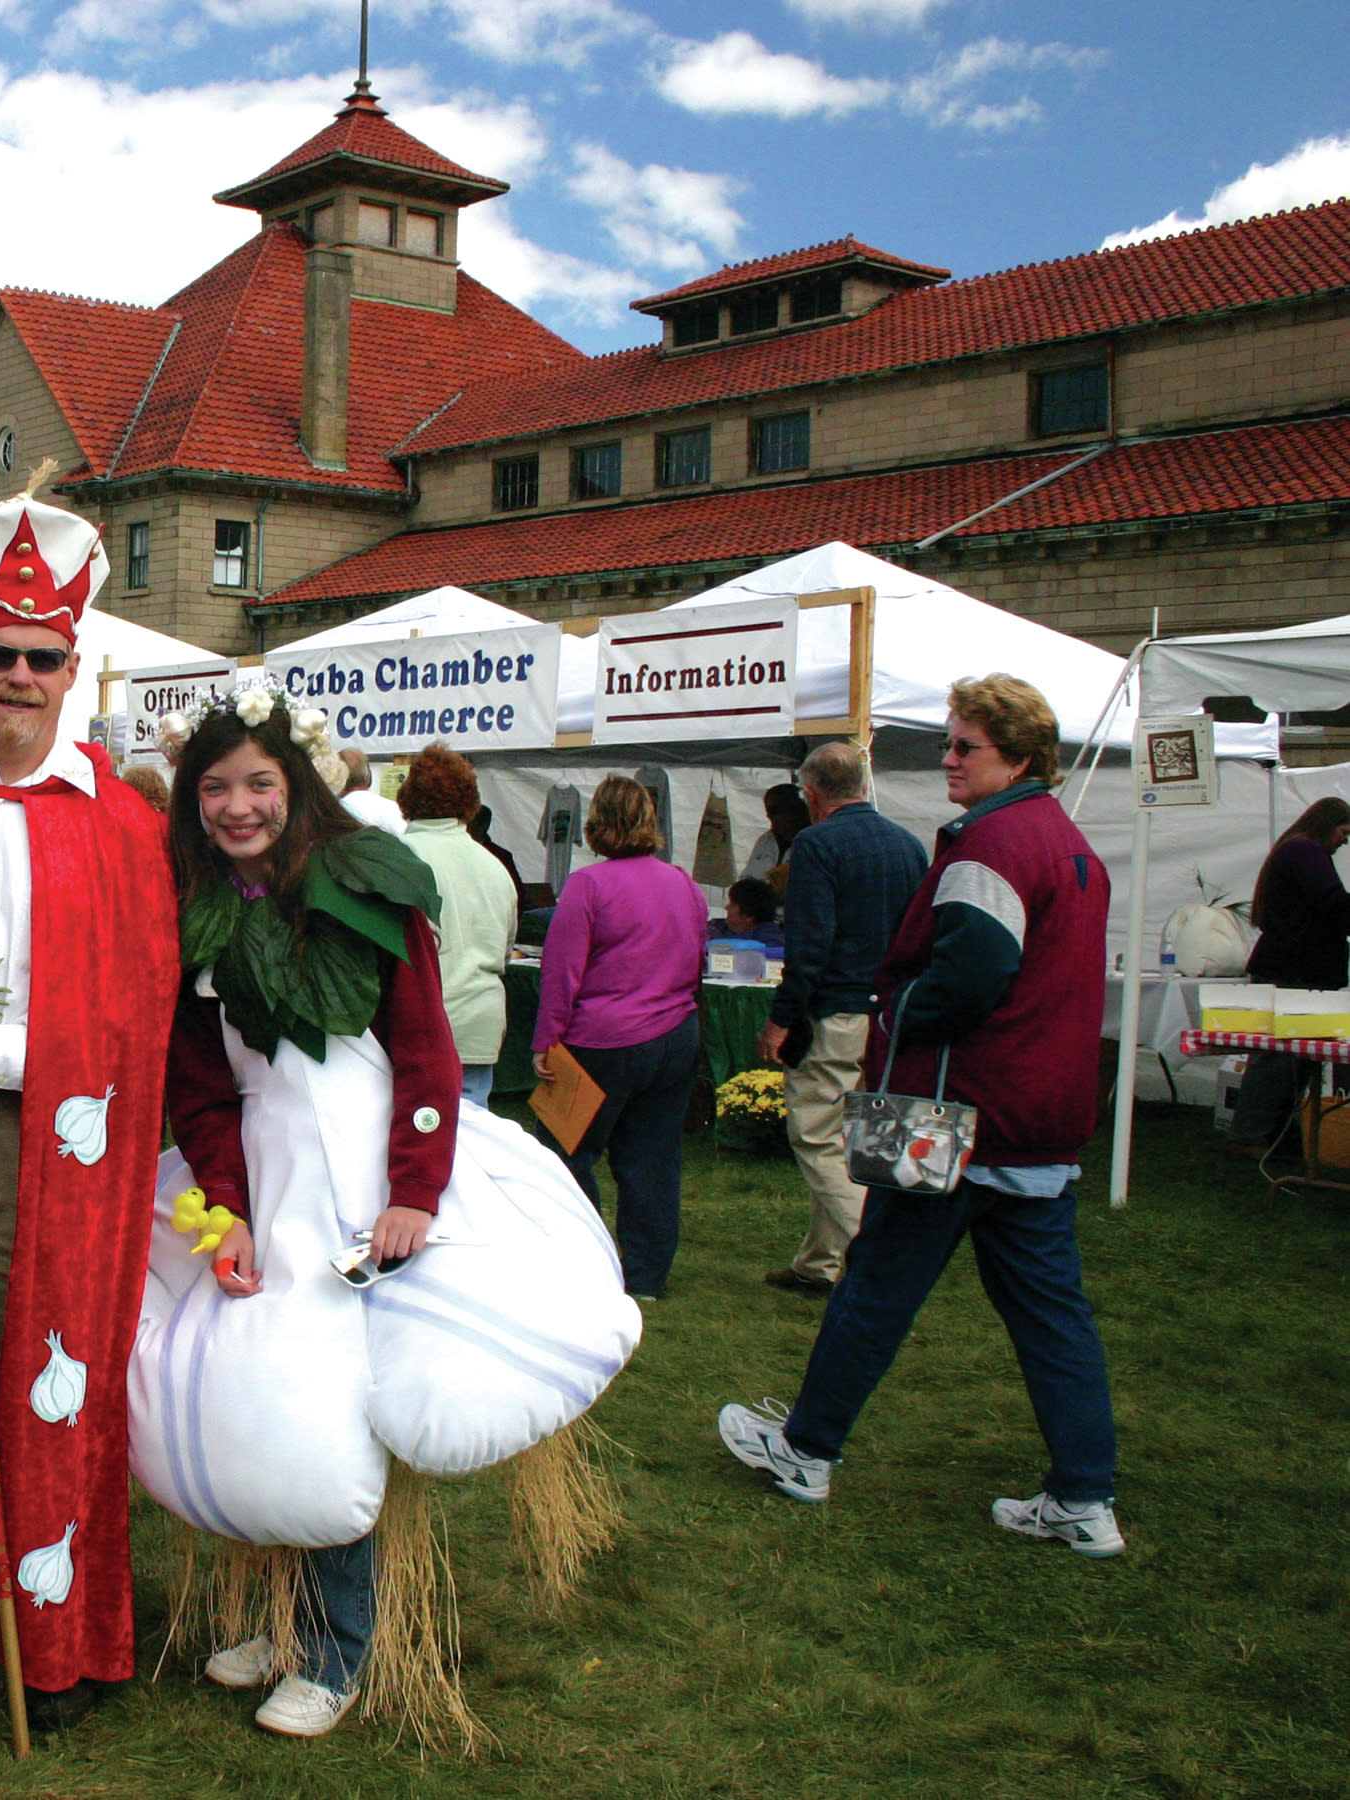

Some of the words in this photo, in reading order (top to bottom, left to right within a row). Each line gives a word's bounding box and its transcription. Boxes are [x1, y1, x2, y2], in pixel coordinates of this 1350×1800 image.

[285, 663, 365, 698] Cuba
[374, 649, 534, 692] Chamber
[604, 654, 786, 695] Information
[144, 684, 216, 712] Officil
[336, 703, 515, 739] Commerce
